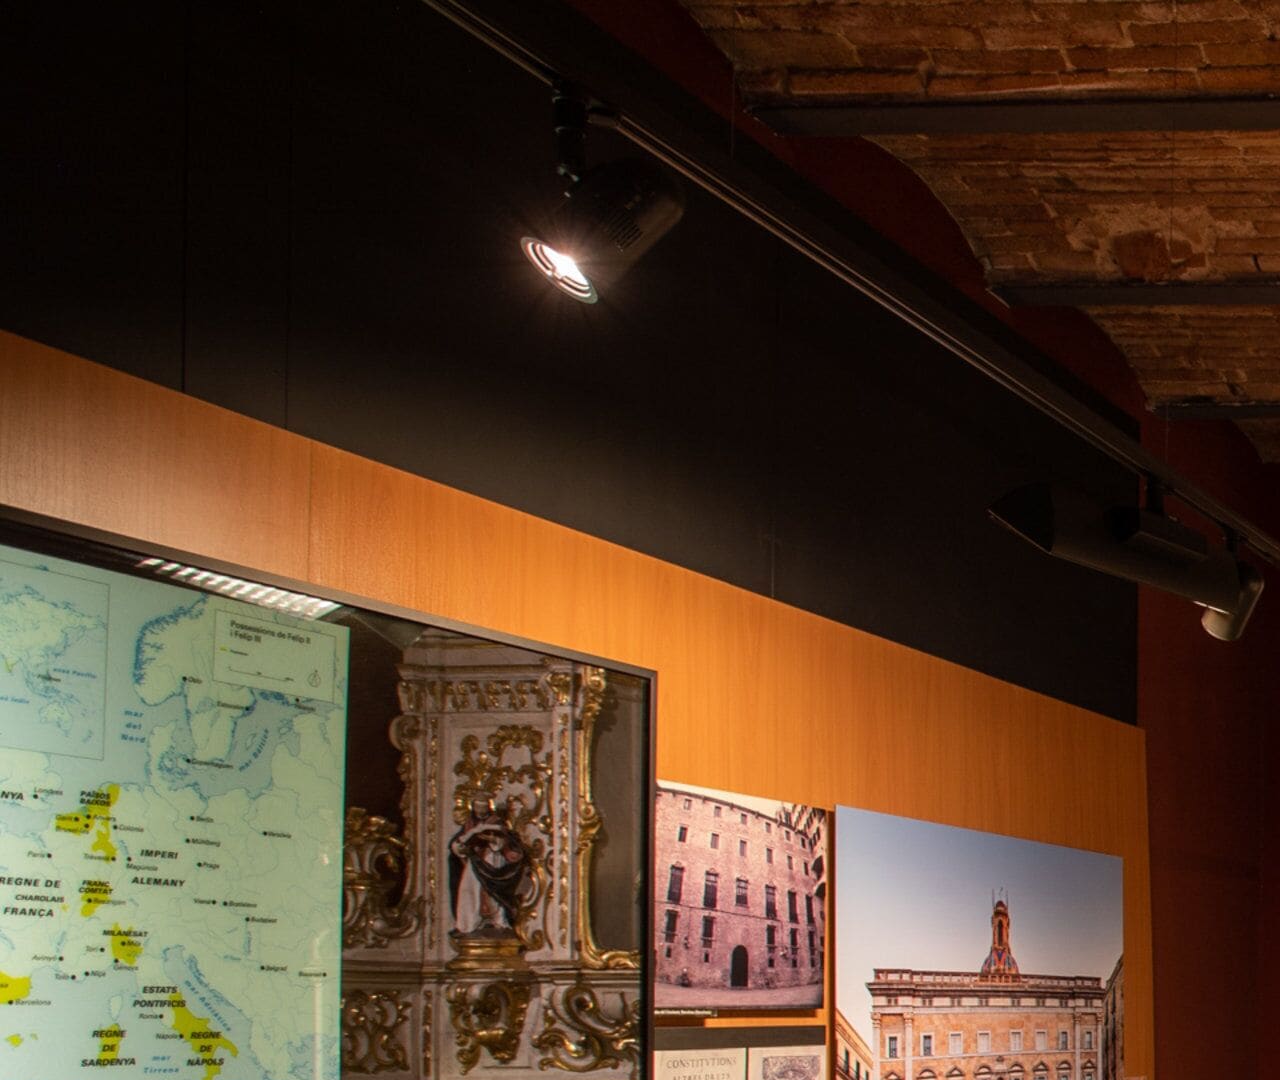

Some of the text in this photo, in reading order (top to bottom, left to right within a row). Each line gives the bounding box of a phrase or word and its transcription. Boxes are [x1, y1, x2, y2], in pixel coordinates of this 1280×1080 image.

[230, 619, 275, 638] Possessions
[120, 734, 146, 745] Nord
[33, 785, 63, 797] Londres
[140, 849, 179, 860] IMPERI
[44, 879, 62, 889] DE
[82, 879, 110, 888] FRANC
[131, 876, 186, 888] ALEMANY
[78, 887, 114, 896] COMTAT
[15, 894, 65, 904] CHAROLAIS
[3, 906, 54, 919] FRANÇA
[102, 929, 149, 938] MILANESAT
[142, 986, 178, 995] ESTATS
[132, 999, 186, 1009] PONTIFICIS
[91, 1029, 127, 1039] REGNE
[190, 1031, 222, 1040] REGNE
[101, 1044, 117, 1053] DE
[199, 1044, 213, 1053] DE
[80, 1057, 137, 1068] SARDENYA
[186, 1056, 224, 1067] NÀPOLS
